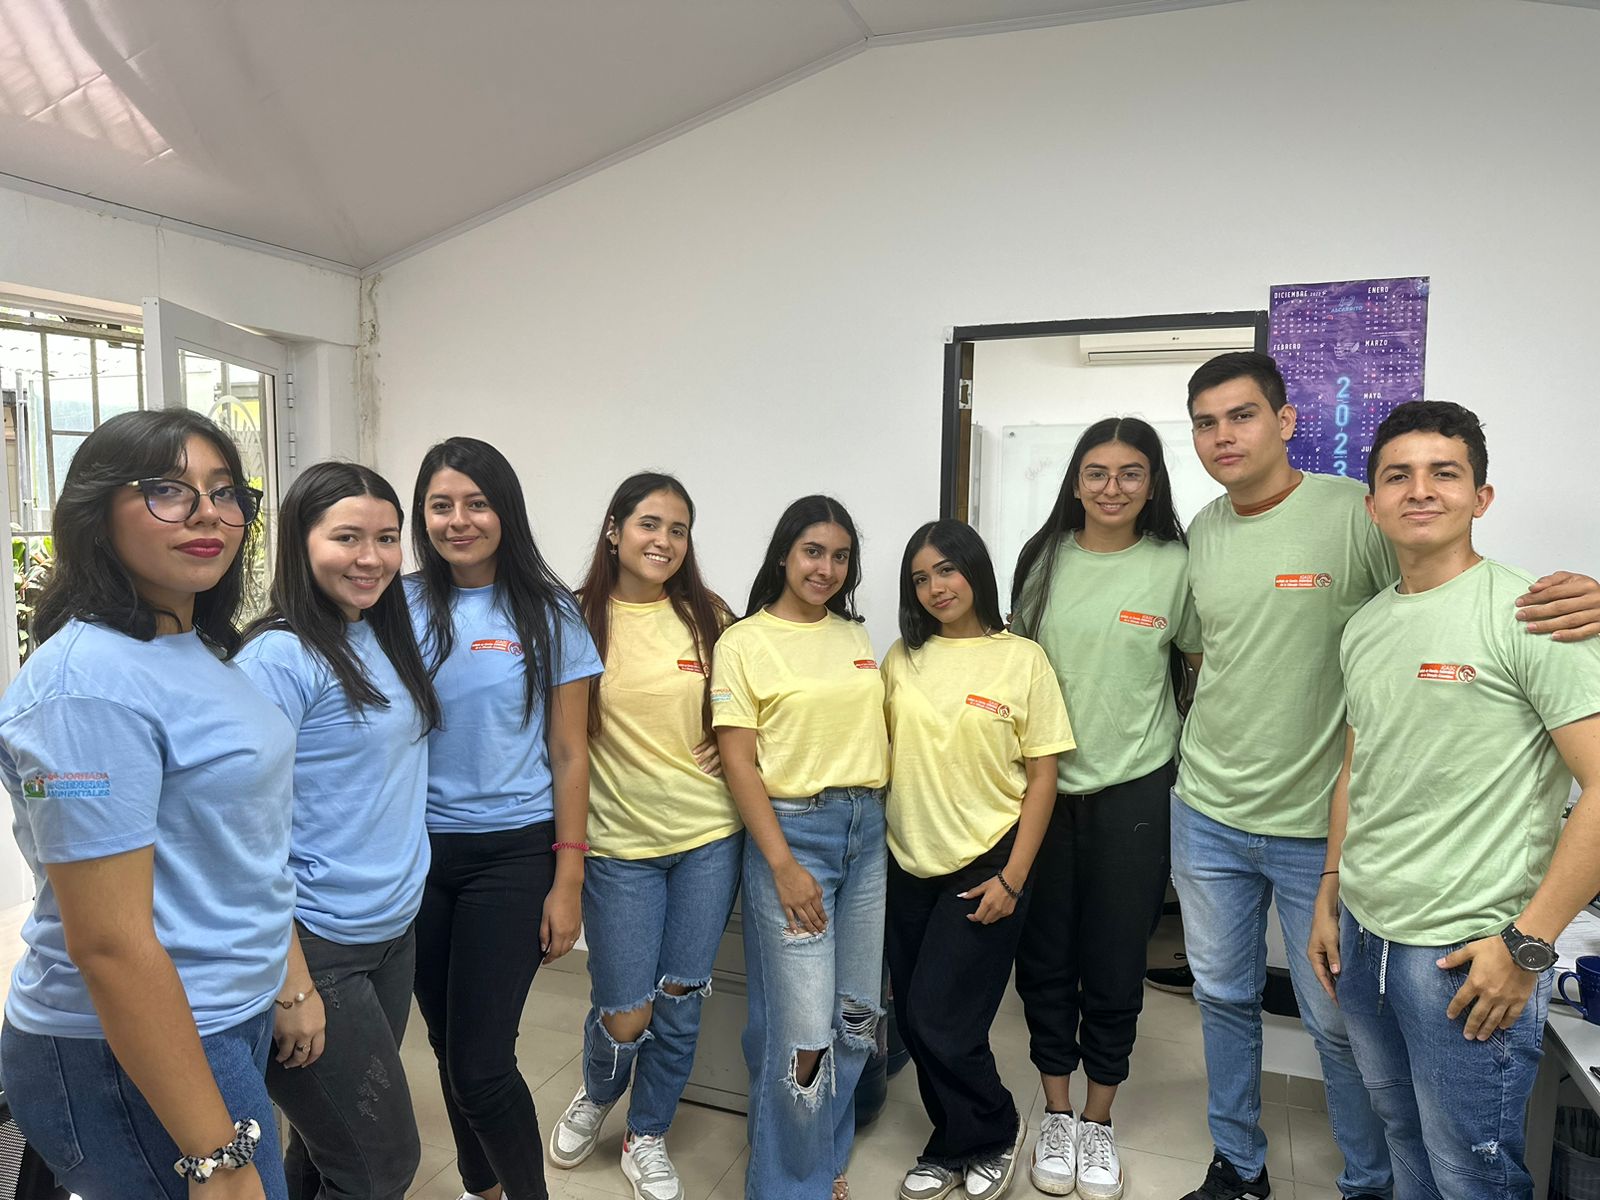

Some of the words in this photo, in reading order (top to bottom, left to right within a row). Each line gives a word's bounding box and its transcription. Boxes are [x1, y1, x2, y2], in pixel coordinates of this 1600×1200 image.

[1367, 286, 1389, 294] ENERO
[1274, 290, 1308, 299] DICIEMBRE
[1273, 343, 1301, 351] FEBRERO
[1364, 339, 1388, 347] MARZO
